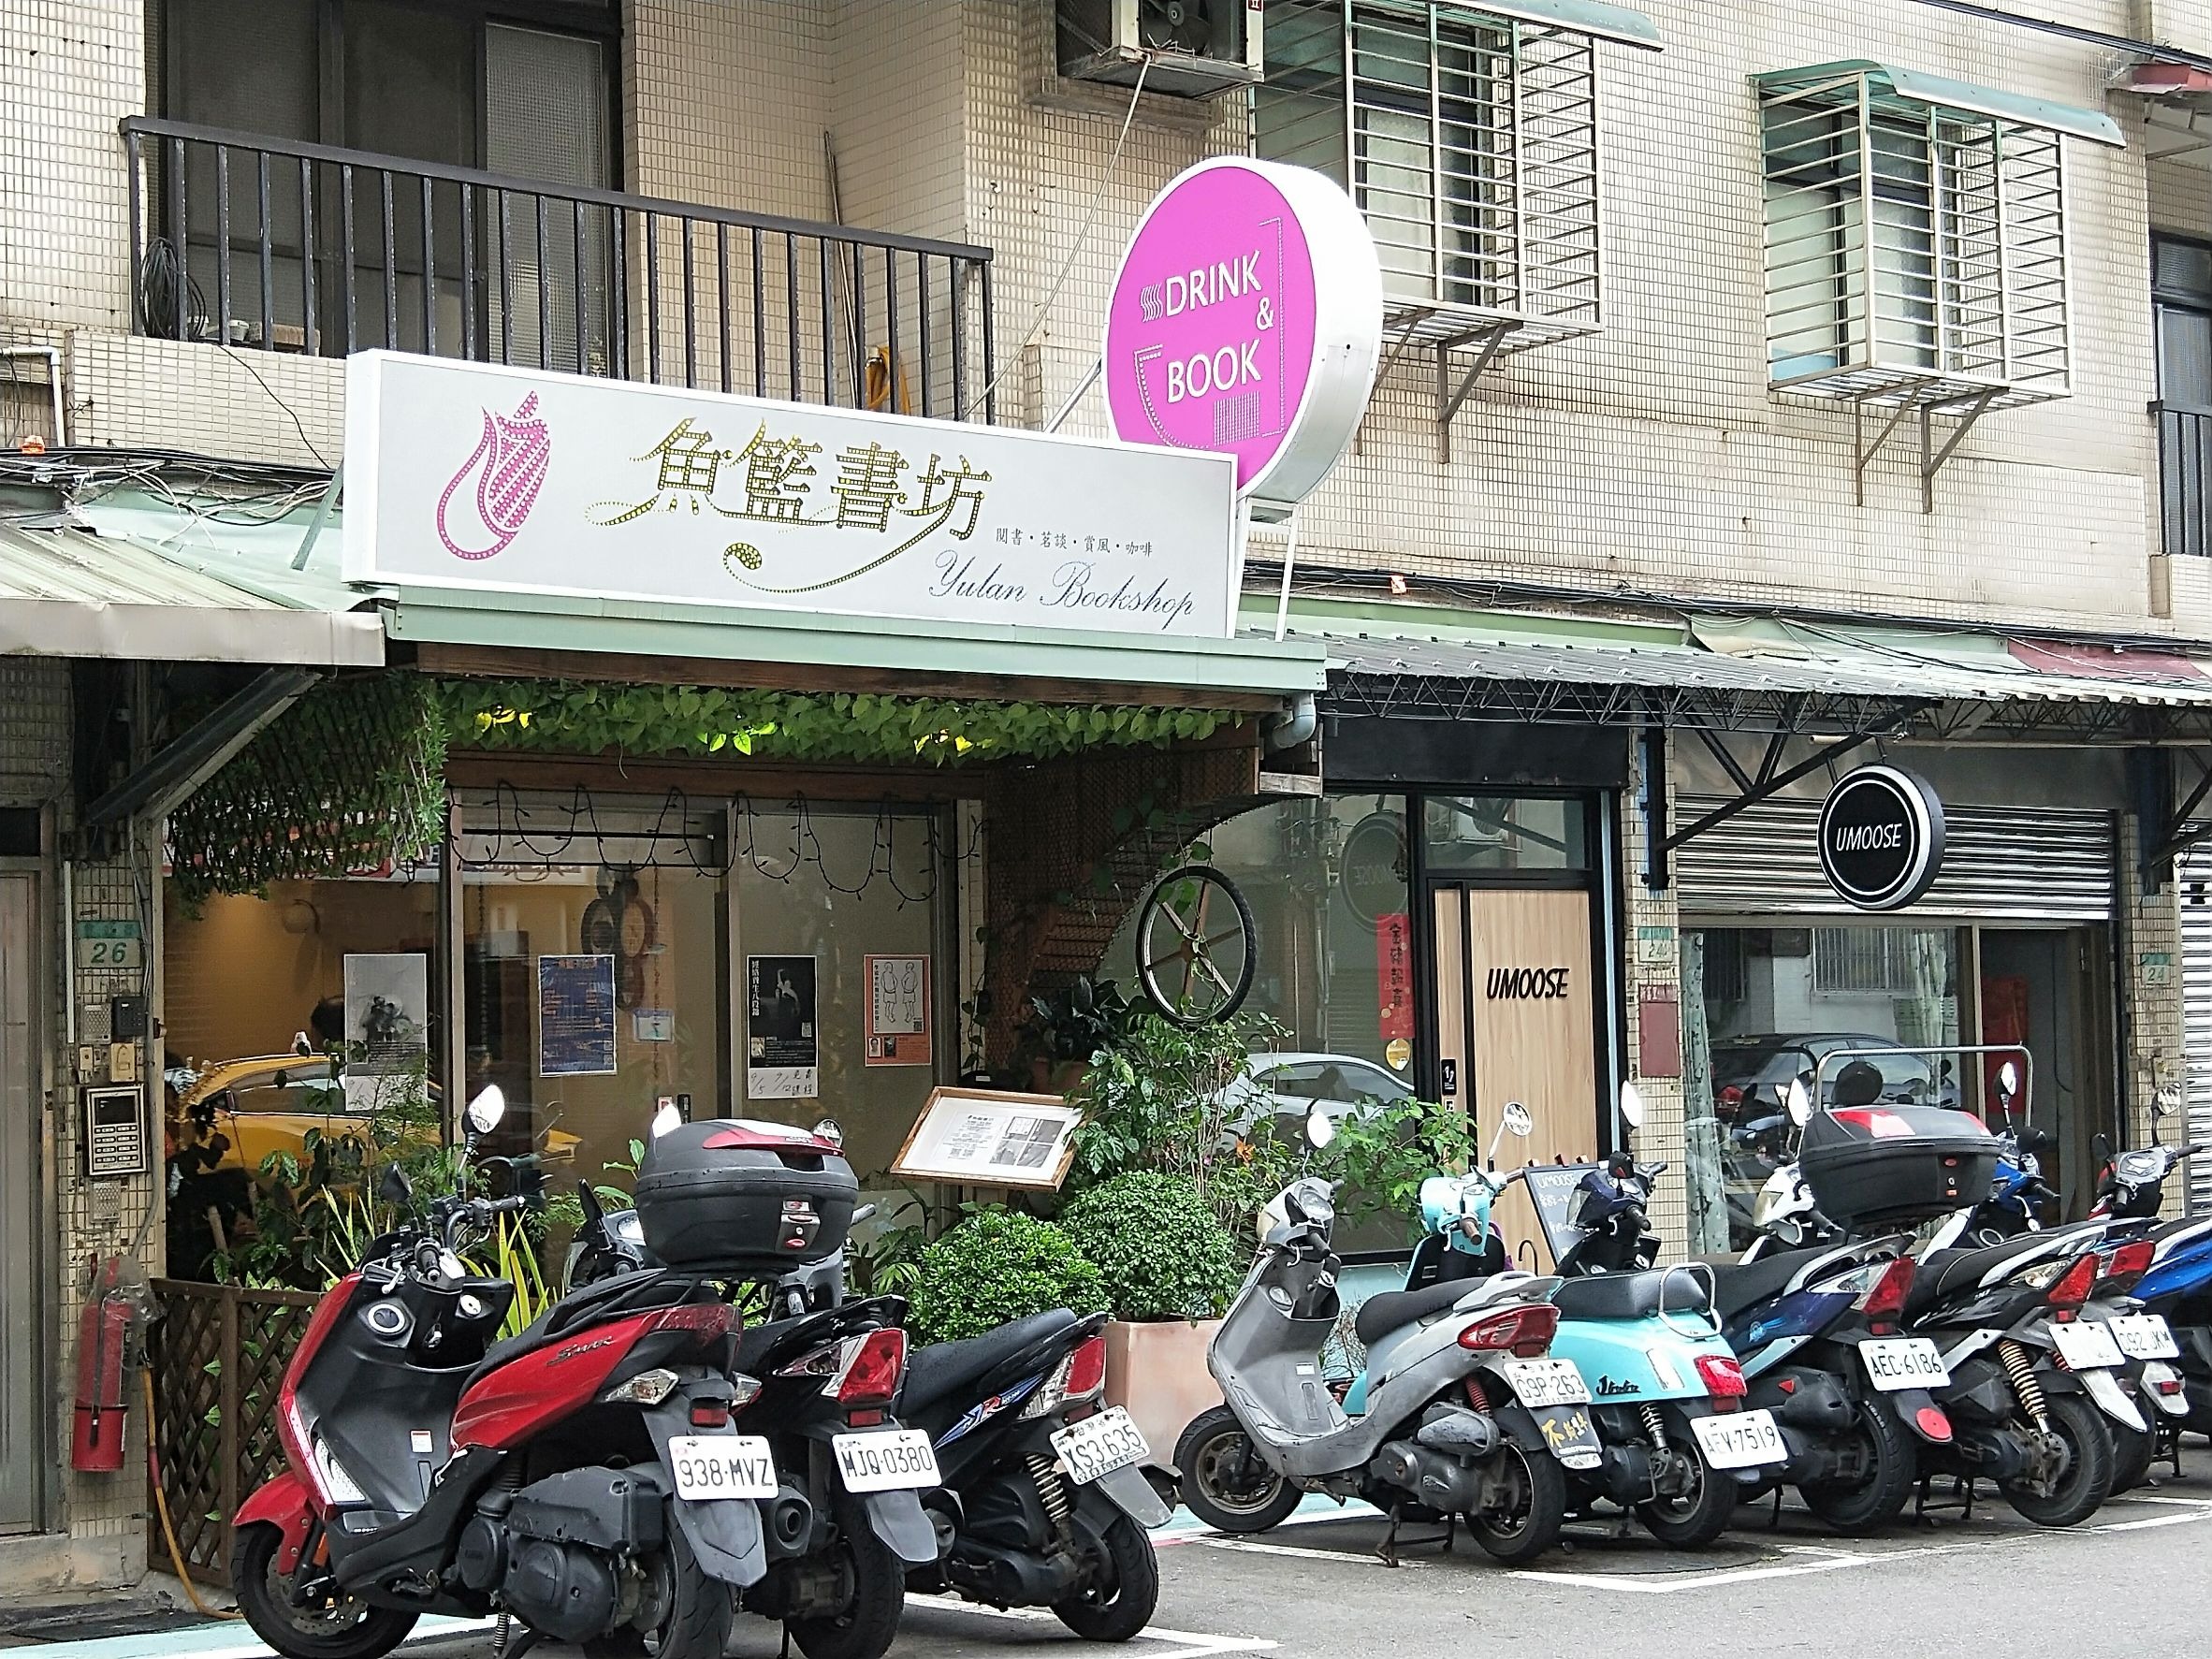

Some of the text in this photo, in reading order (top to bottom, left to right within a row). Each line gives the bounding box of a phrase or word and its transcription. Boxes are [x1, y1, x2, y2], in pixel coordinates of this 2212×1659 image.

[1166, 249, 1262, 316] DRINK
[1256, 297, 1274, 330] &
[1167, 338, 1262, 403] BOOK
[929, 549, 1196, 630] Yulan Bookshop
[1836, 822, 1902, 851] UMOOSE
[91, 942, 127, 964] 26
[1486, 968, 1569, 999] UMOOSE
